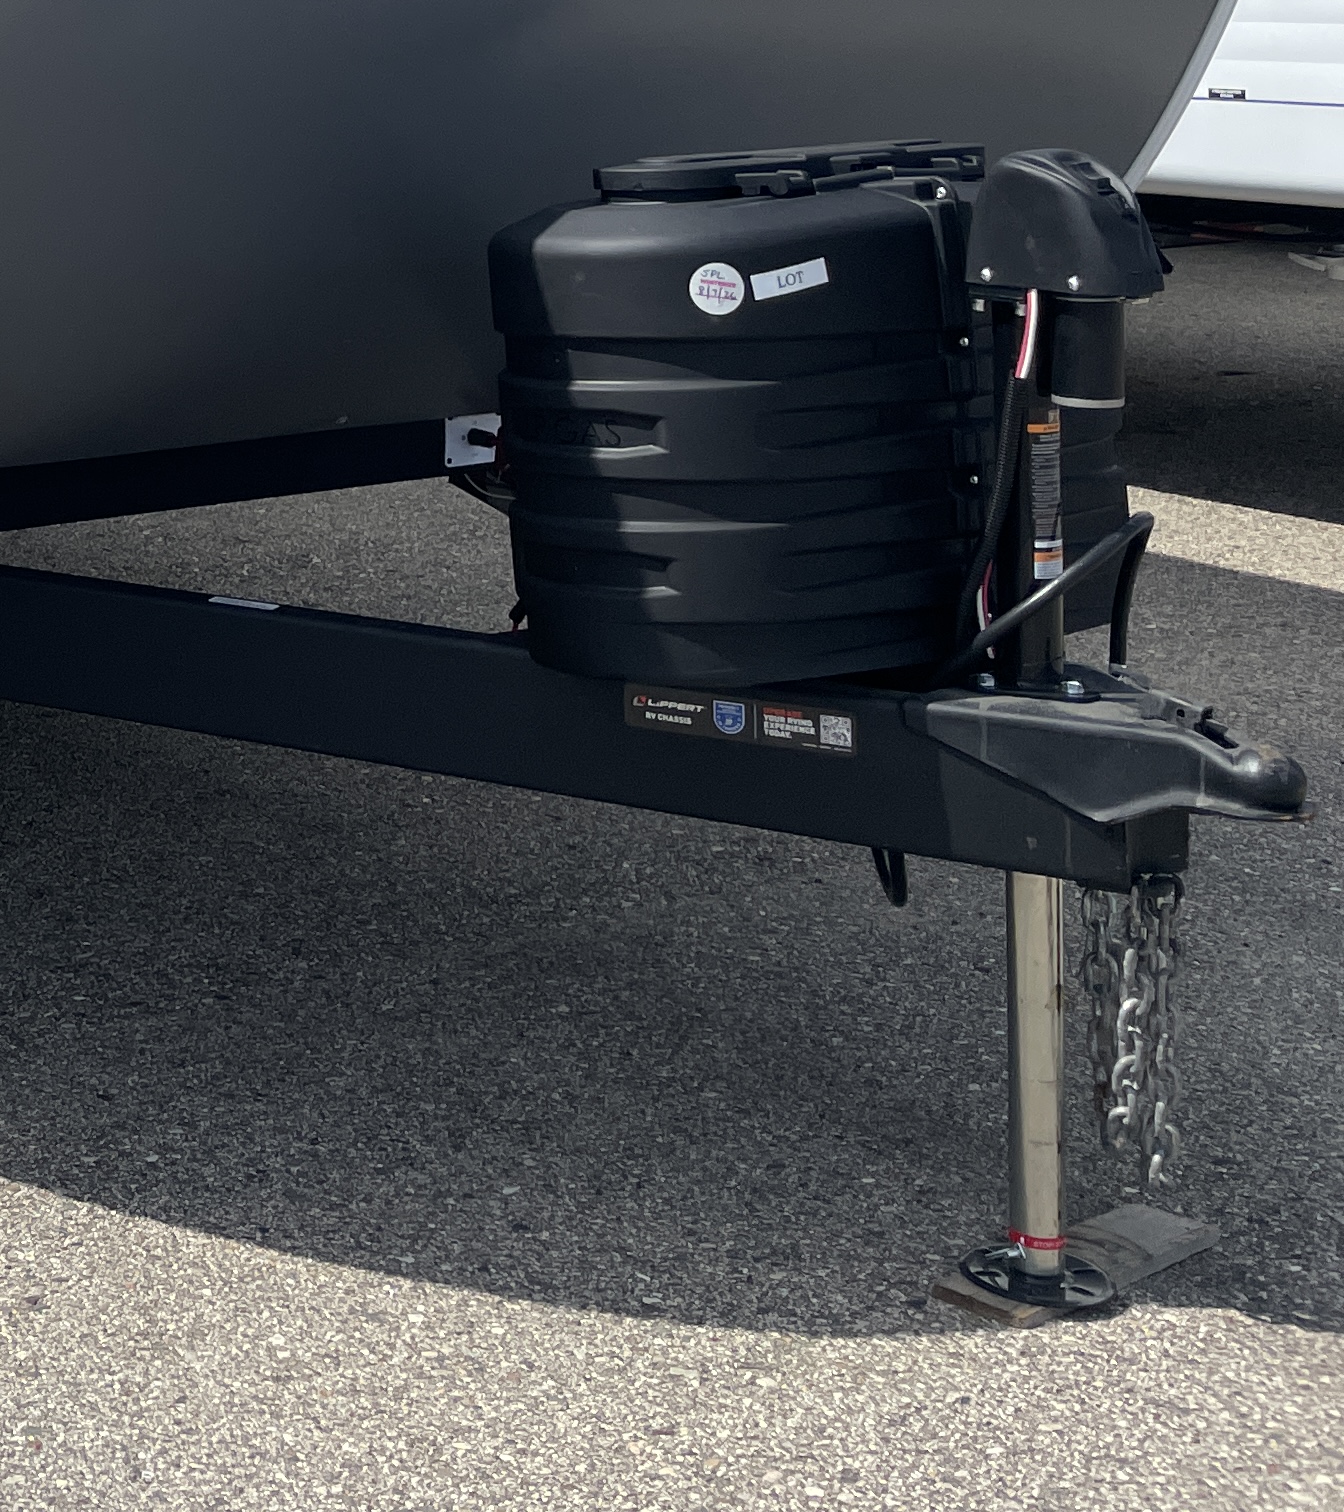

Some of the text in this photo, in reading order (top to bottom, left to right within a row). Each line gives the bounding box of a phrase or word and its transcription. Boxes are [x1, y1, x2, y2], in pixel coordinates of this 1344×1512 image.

[777, 270, 805, 289] LOT
[647, 699, 705, 712] LIPPERT
[645, 711, 693, 726] RV CHASSIS
